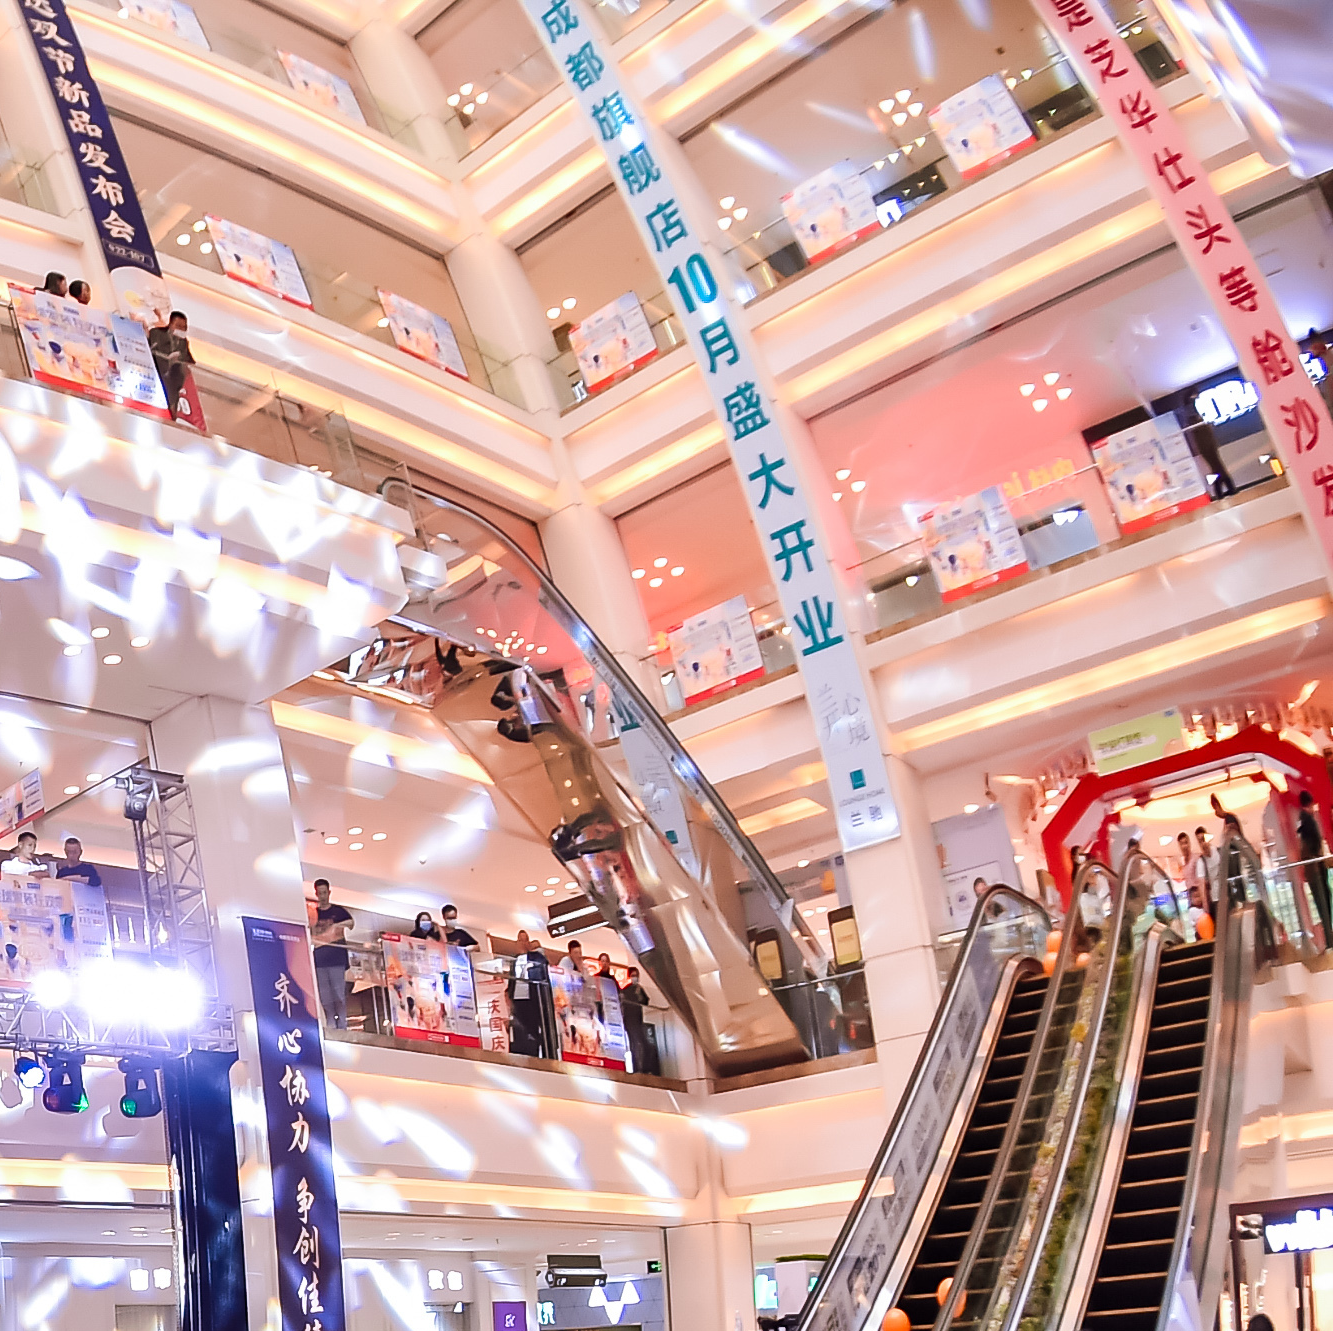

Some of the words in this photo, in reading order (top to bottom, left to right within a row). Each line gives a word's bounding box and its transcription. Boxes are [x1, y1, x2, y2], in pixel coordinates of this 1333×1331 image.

[272, 971, 311, 1155] 齐心协力
[487, 1000, 506, 1051] 庆国庆
